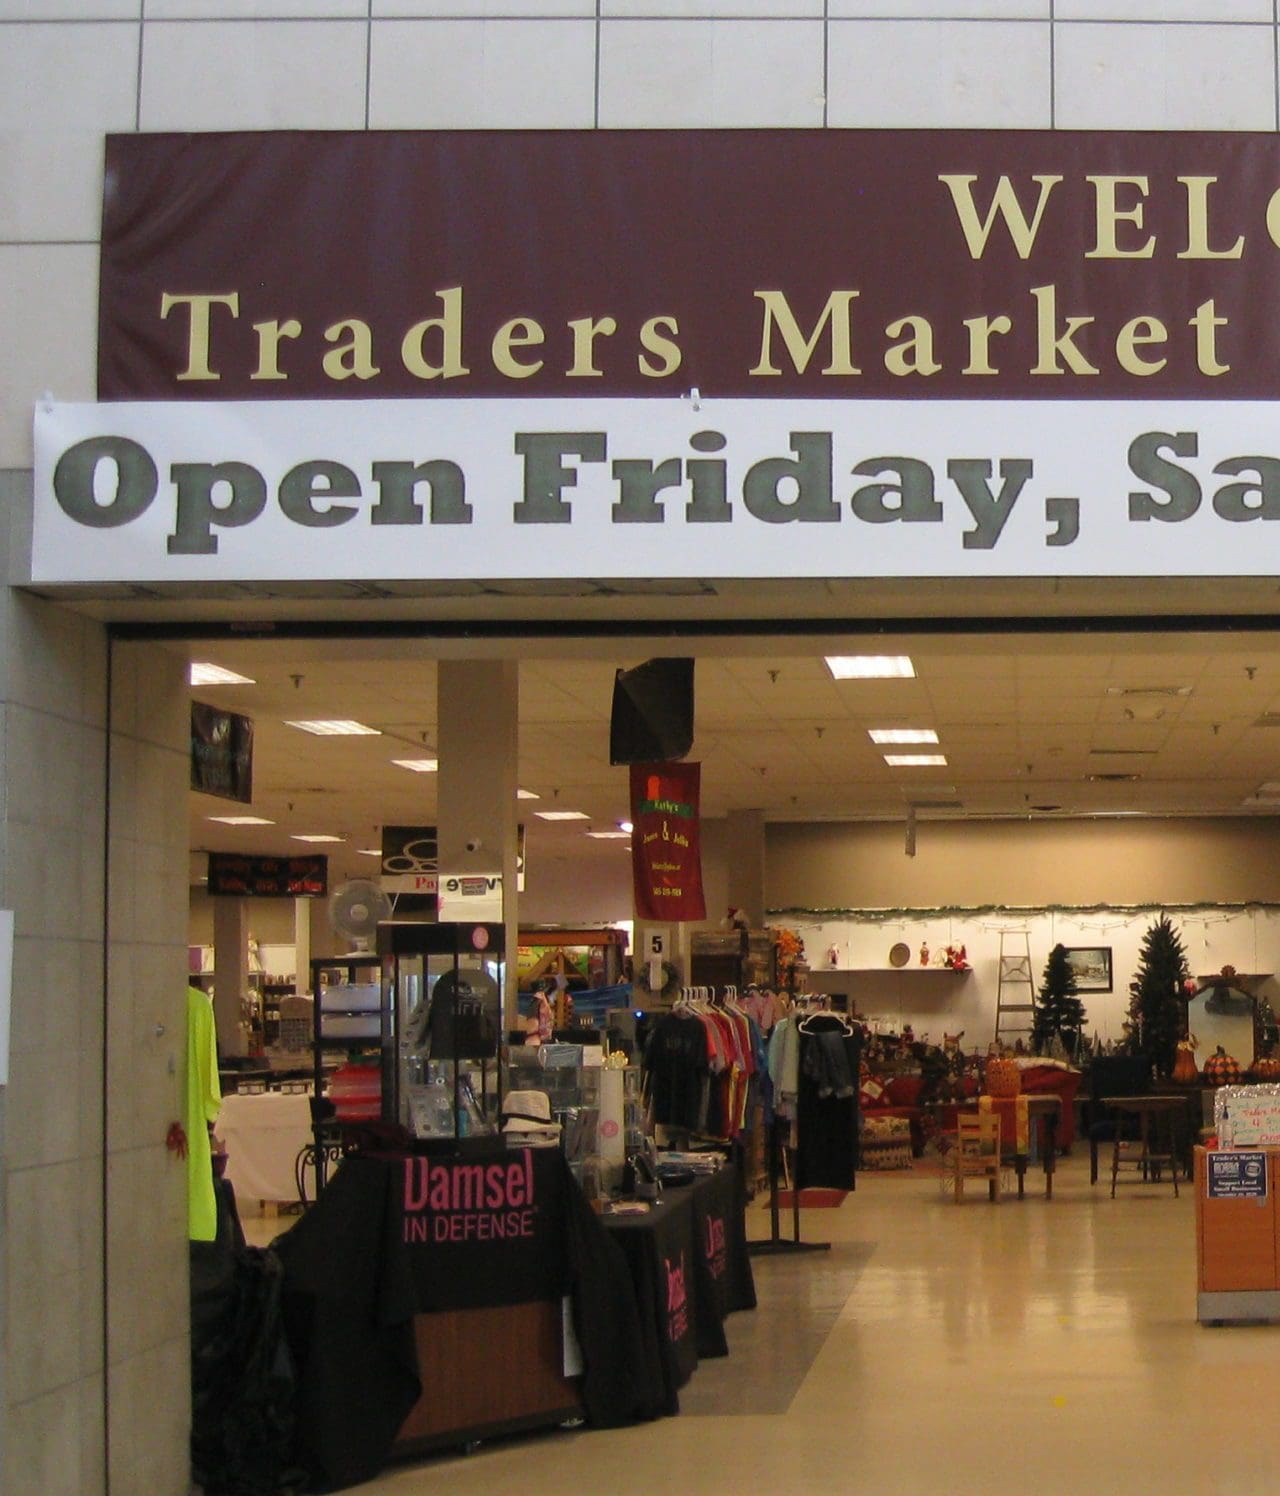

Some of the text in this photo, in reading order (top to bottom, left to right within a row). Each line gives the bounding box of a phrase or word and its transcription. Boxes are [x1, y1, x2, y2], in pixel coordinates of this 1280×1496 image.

[160, 286, 682, 380] Traders
[750, 284, 1231, 377] Market
[52, 435, 473, 556] Open
[513, 430, 1080, 550] Friday,
[652, 935, 663, 953] 5
[403, 1148, 534, 1212] Damsel
[403, 1210, 535, 1243] IN DEFENSE
